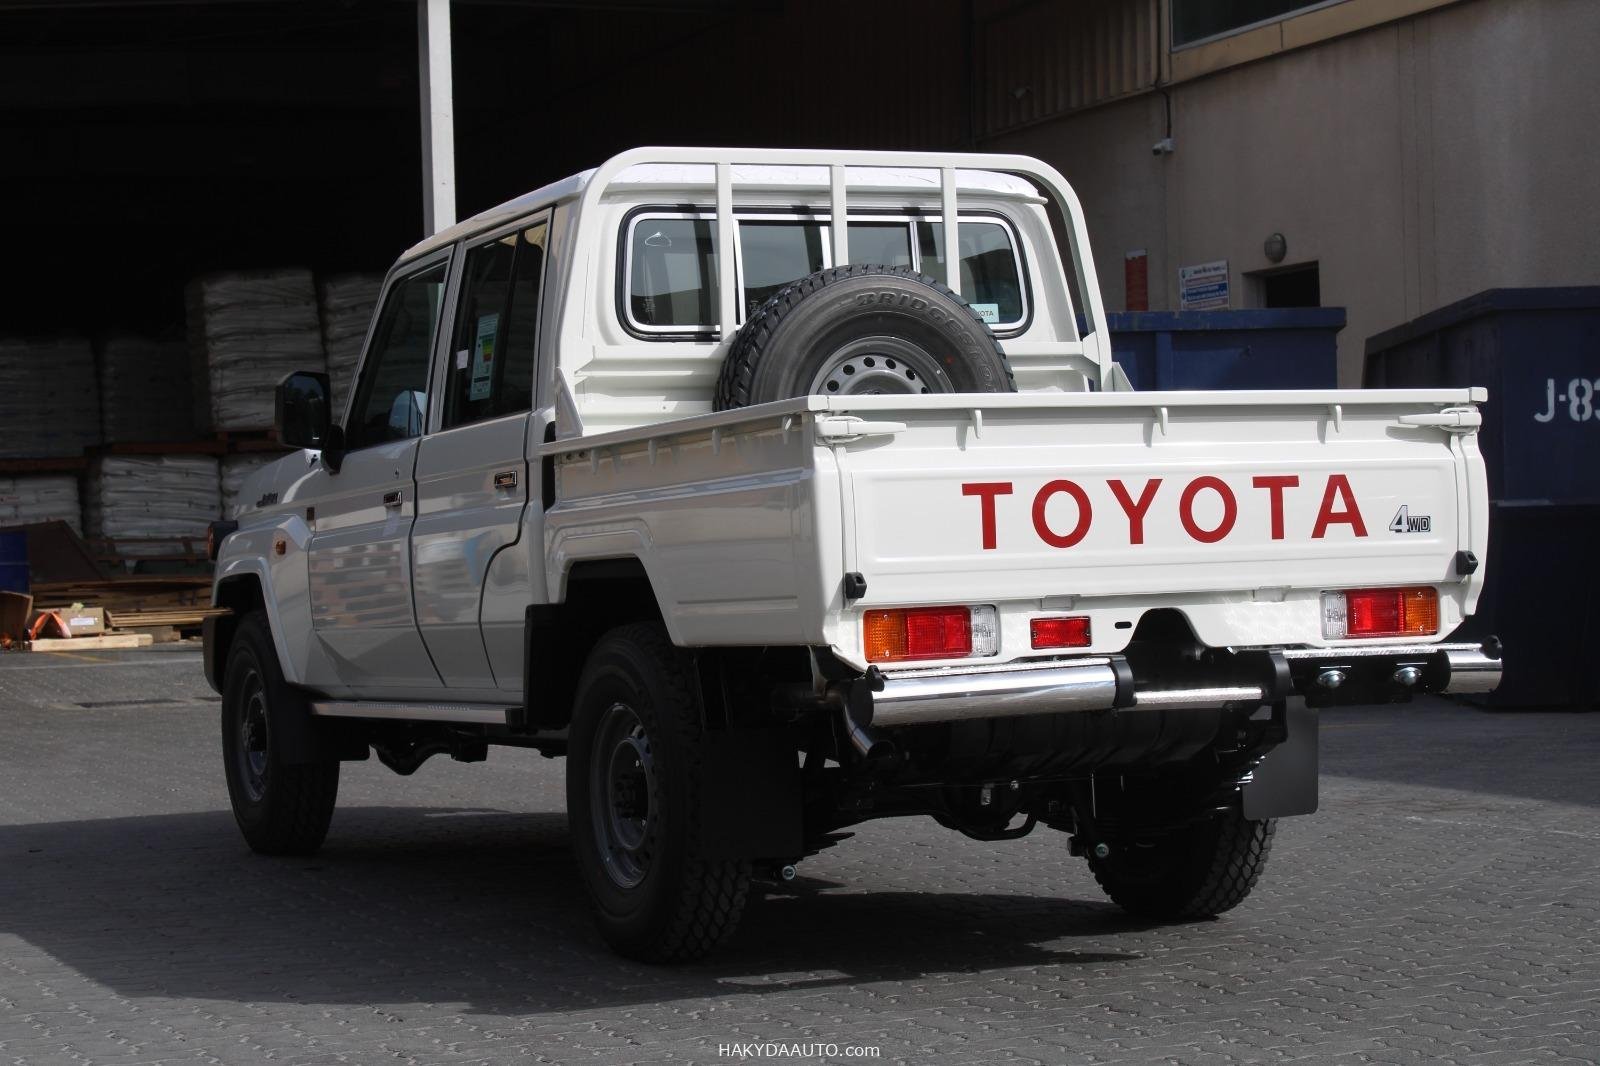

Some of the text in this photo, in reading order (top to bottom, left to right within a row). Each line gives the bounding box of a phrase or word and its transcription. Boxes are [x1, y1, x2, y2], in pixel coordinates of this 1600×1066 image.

[1534, 378, 1600, 422] J-8
[961, 474, 1369, 550] TOYOTA
[1389, 504, 1431, 533] 4WD
